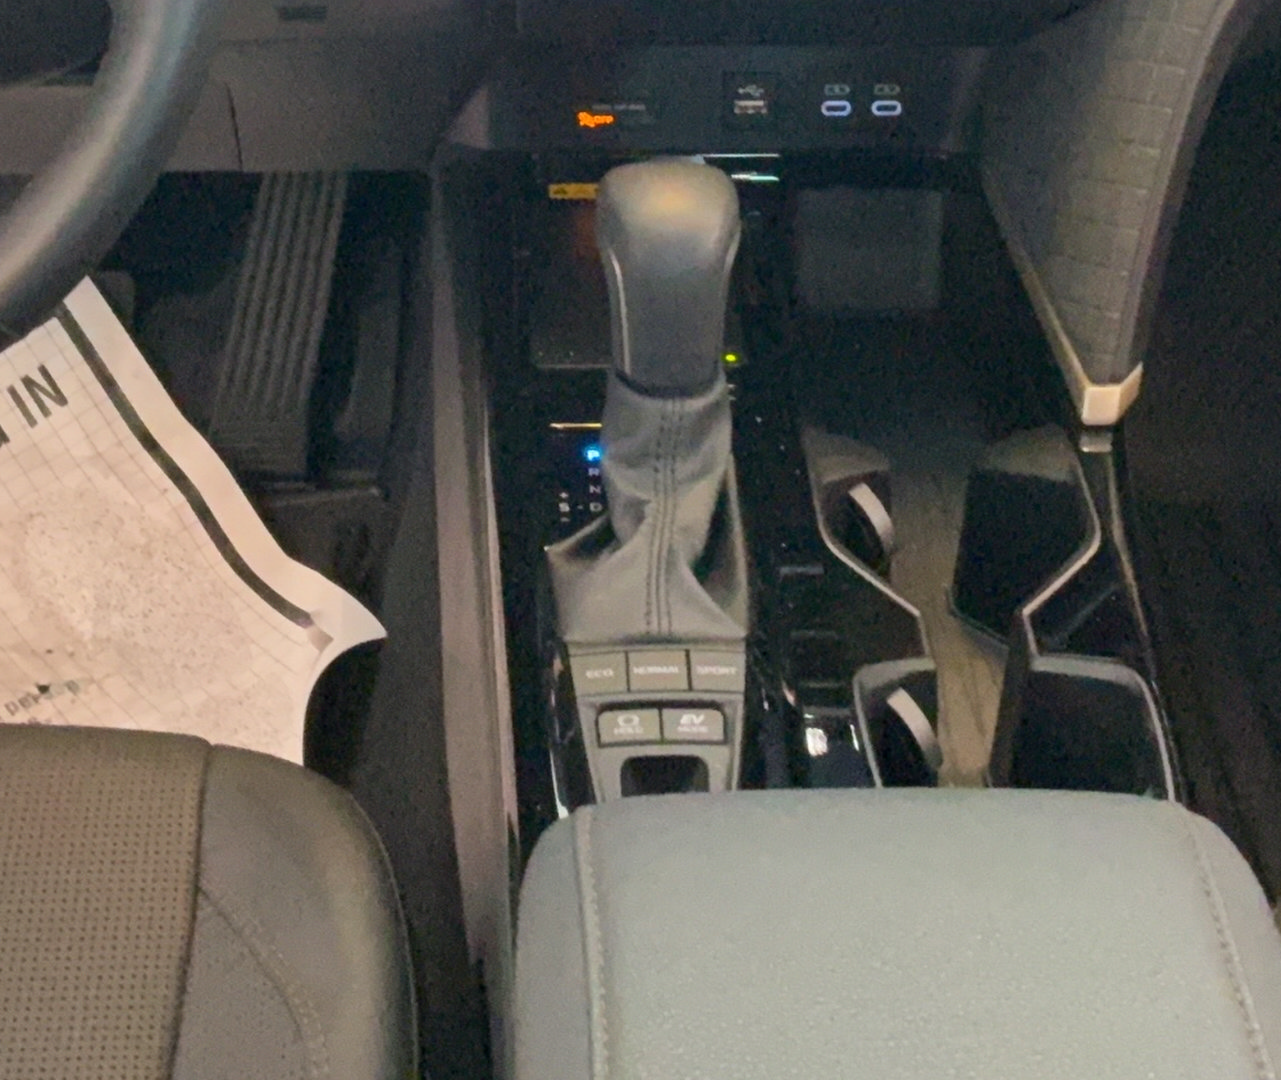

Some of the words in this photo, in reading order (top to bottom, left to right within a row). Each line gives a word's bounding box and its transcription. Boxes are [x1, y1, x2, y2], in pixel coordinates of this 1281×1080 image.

[7, 364, 68, 428] IN
[587, 449, 600, 461] P
[589, 485, 601, 493] N
[589, 502, 602, 512] D
[585, 668, 614, 679] ECO
[632, 665, 679, 675] NORMAL
[696, 665, 737, 675] SPORT
[679, 713, 705, 725] EV
